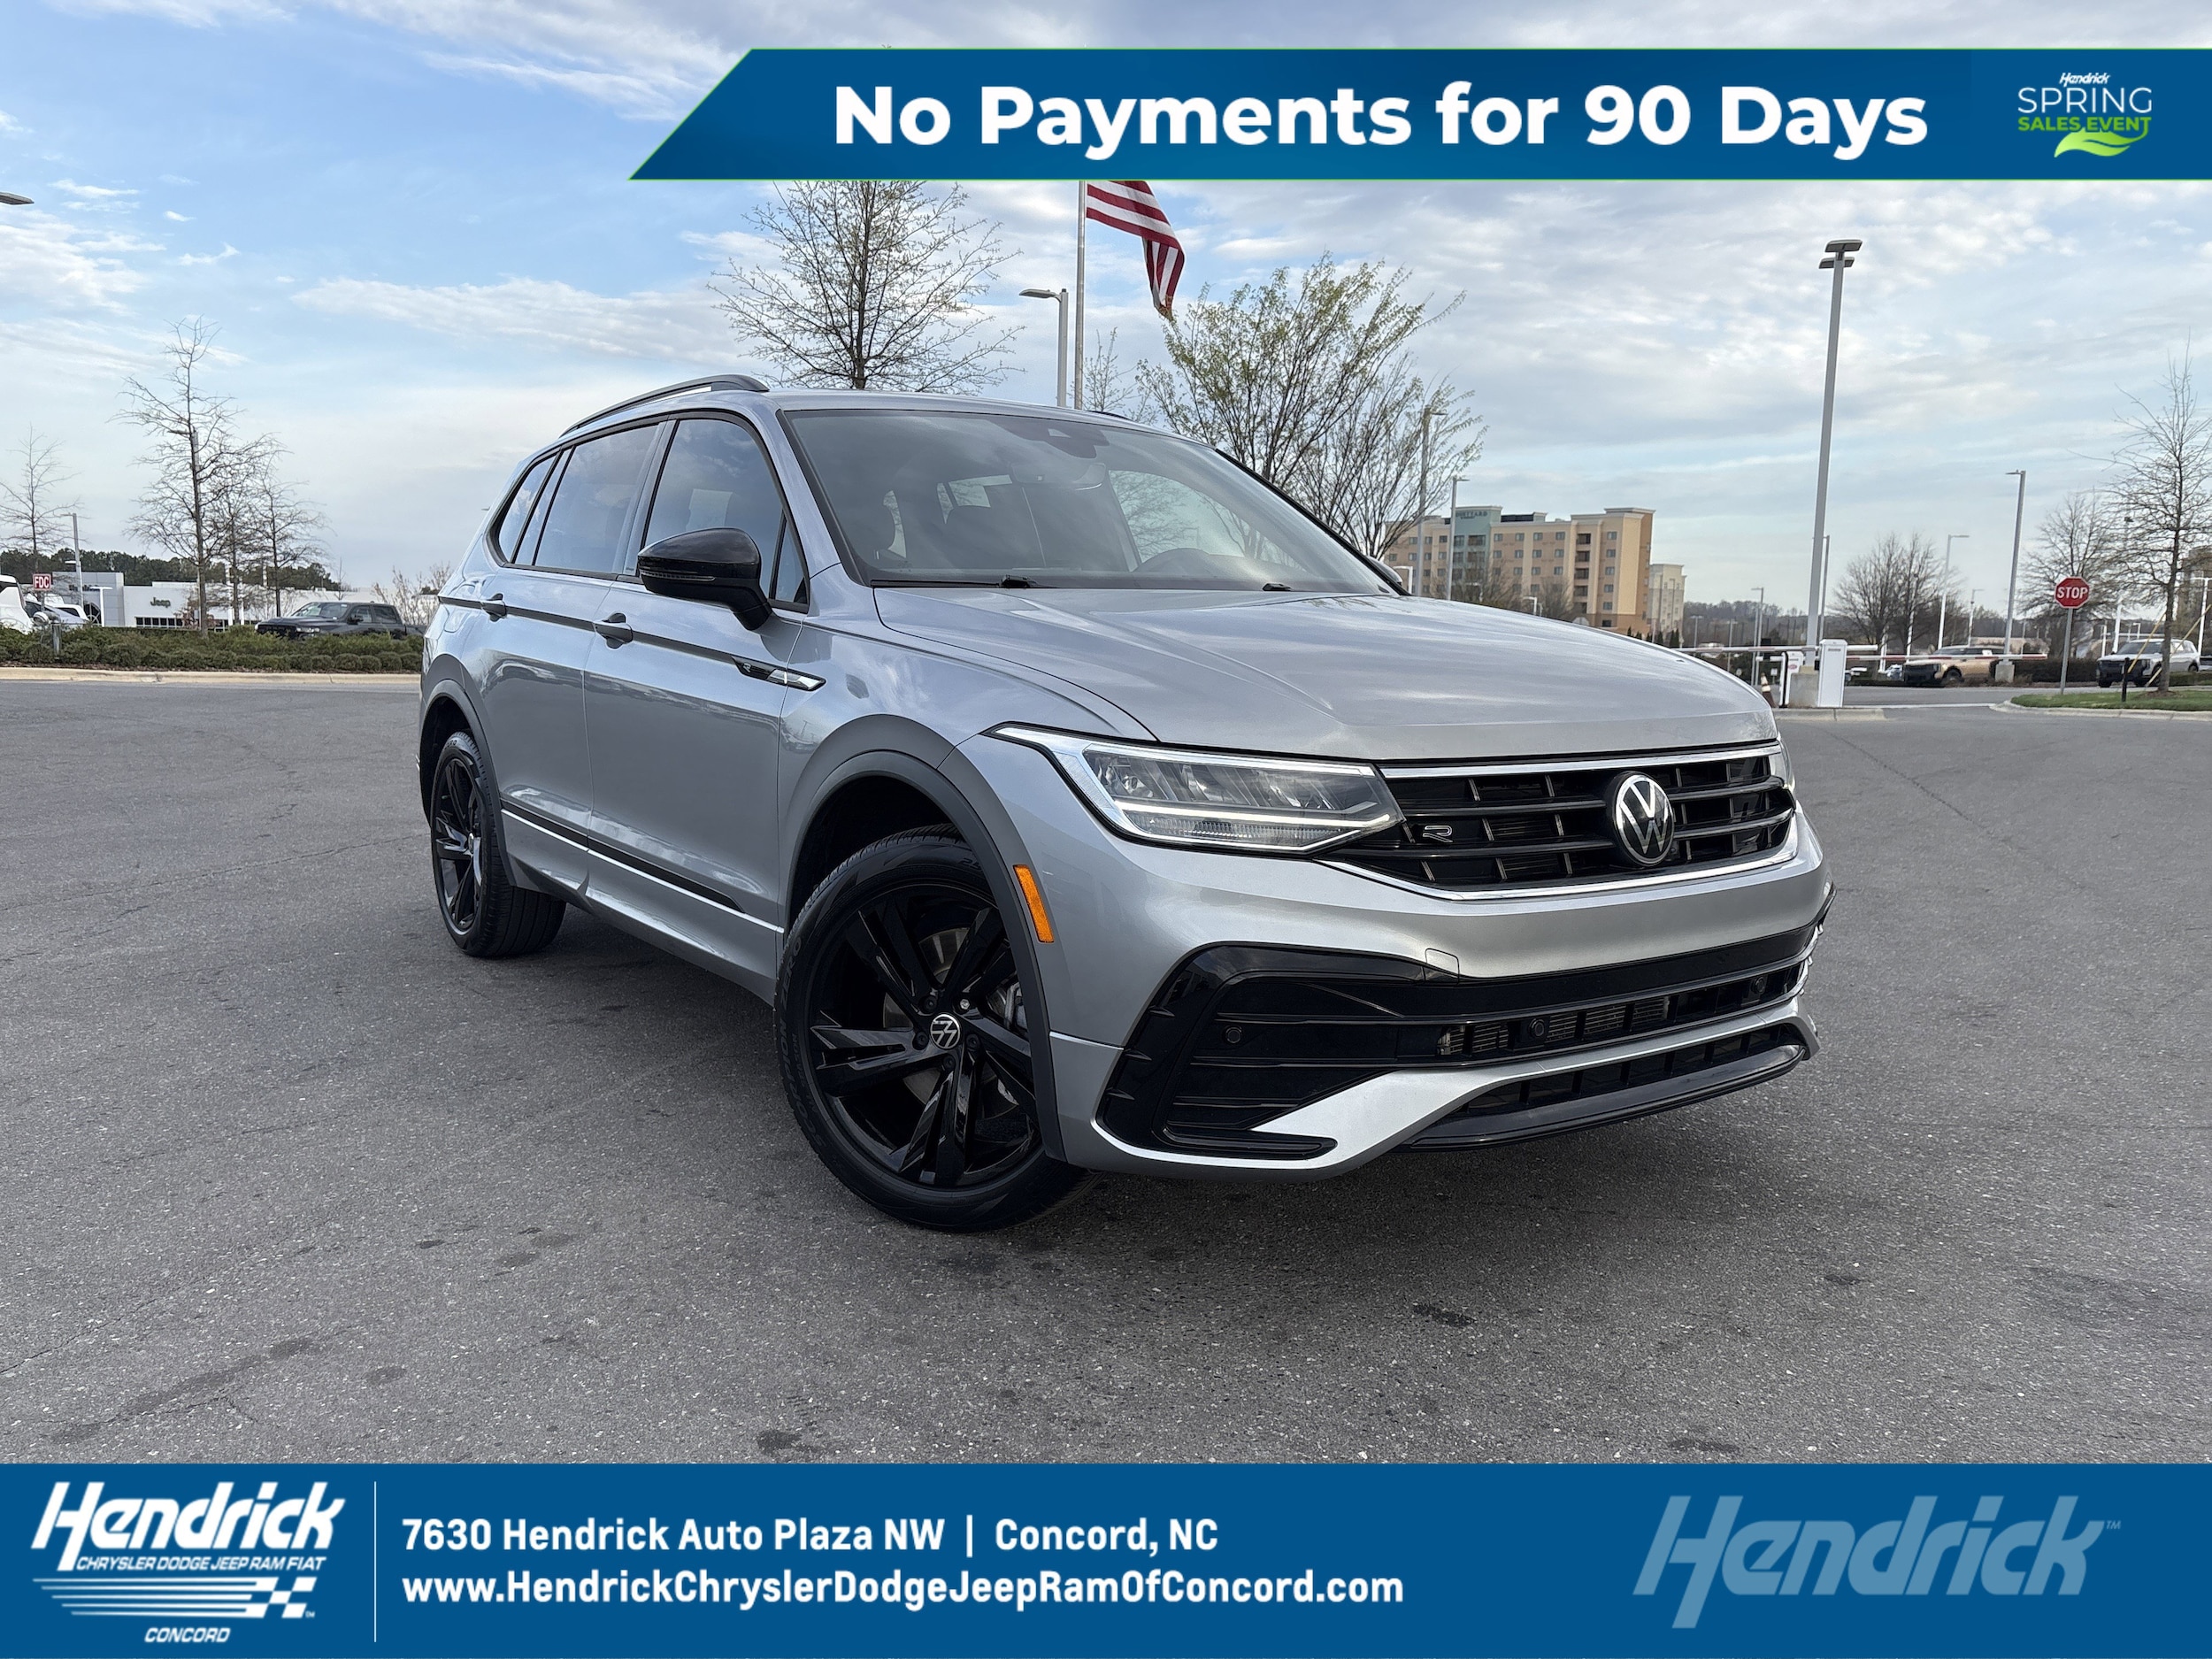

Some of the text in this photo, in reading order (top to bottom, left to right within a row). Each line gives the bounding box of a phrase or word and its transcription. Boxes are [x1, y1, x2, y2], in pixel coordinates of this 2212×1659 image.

[35, 576, 50, 588] FDC
[2056, 586, 2088, 599] STOP
[150, 596, 171, 609] Jeep
[1423, 825, 1453, 842] R
[780, 936, 826, 1148] SCORPION ZERO
